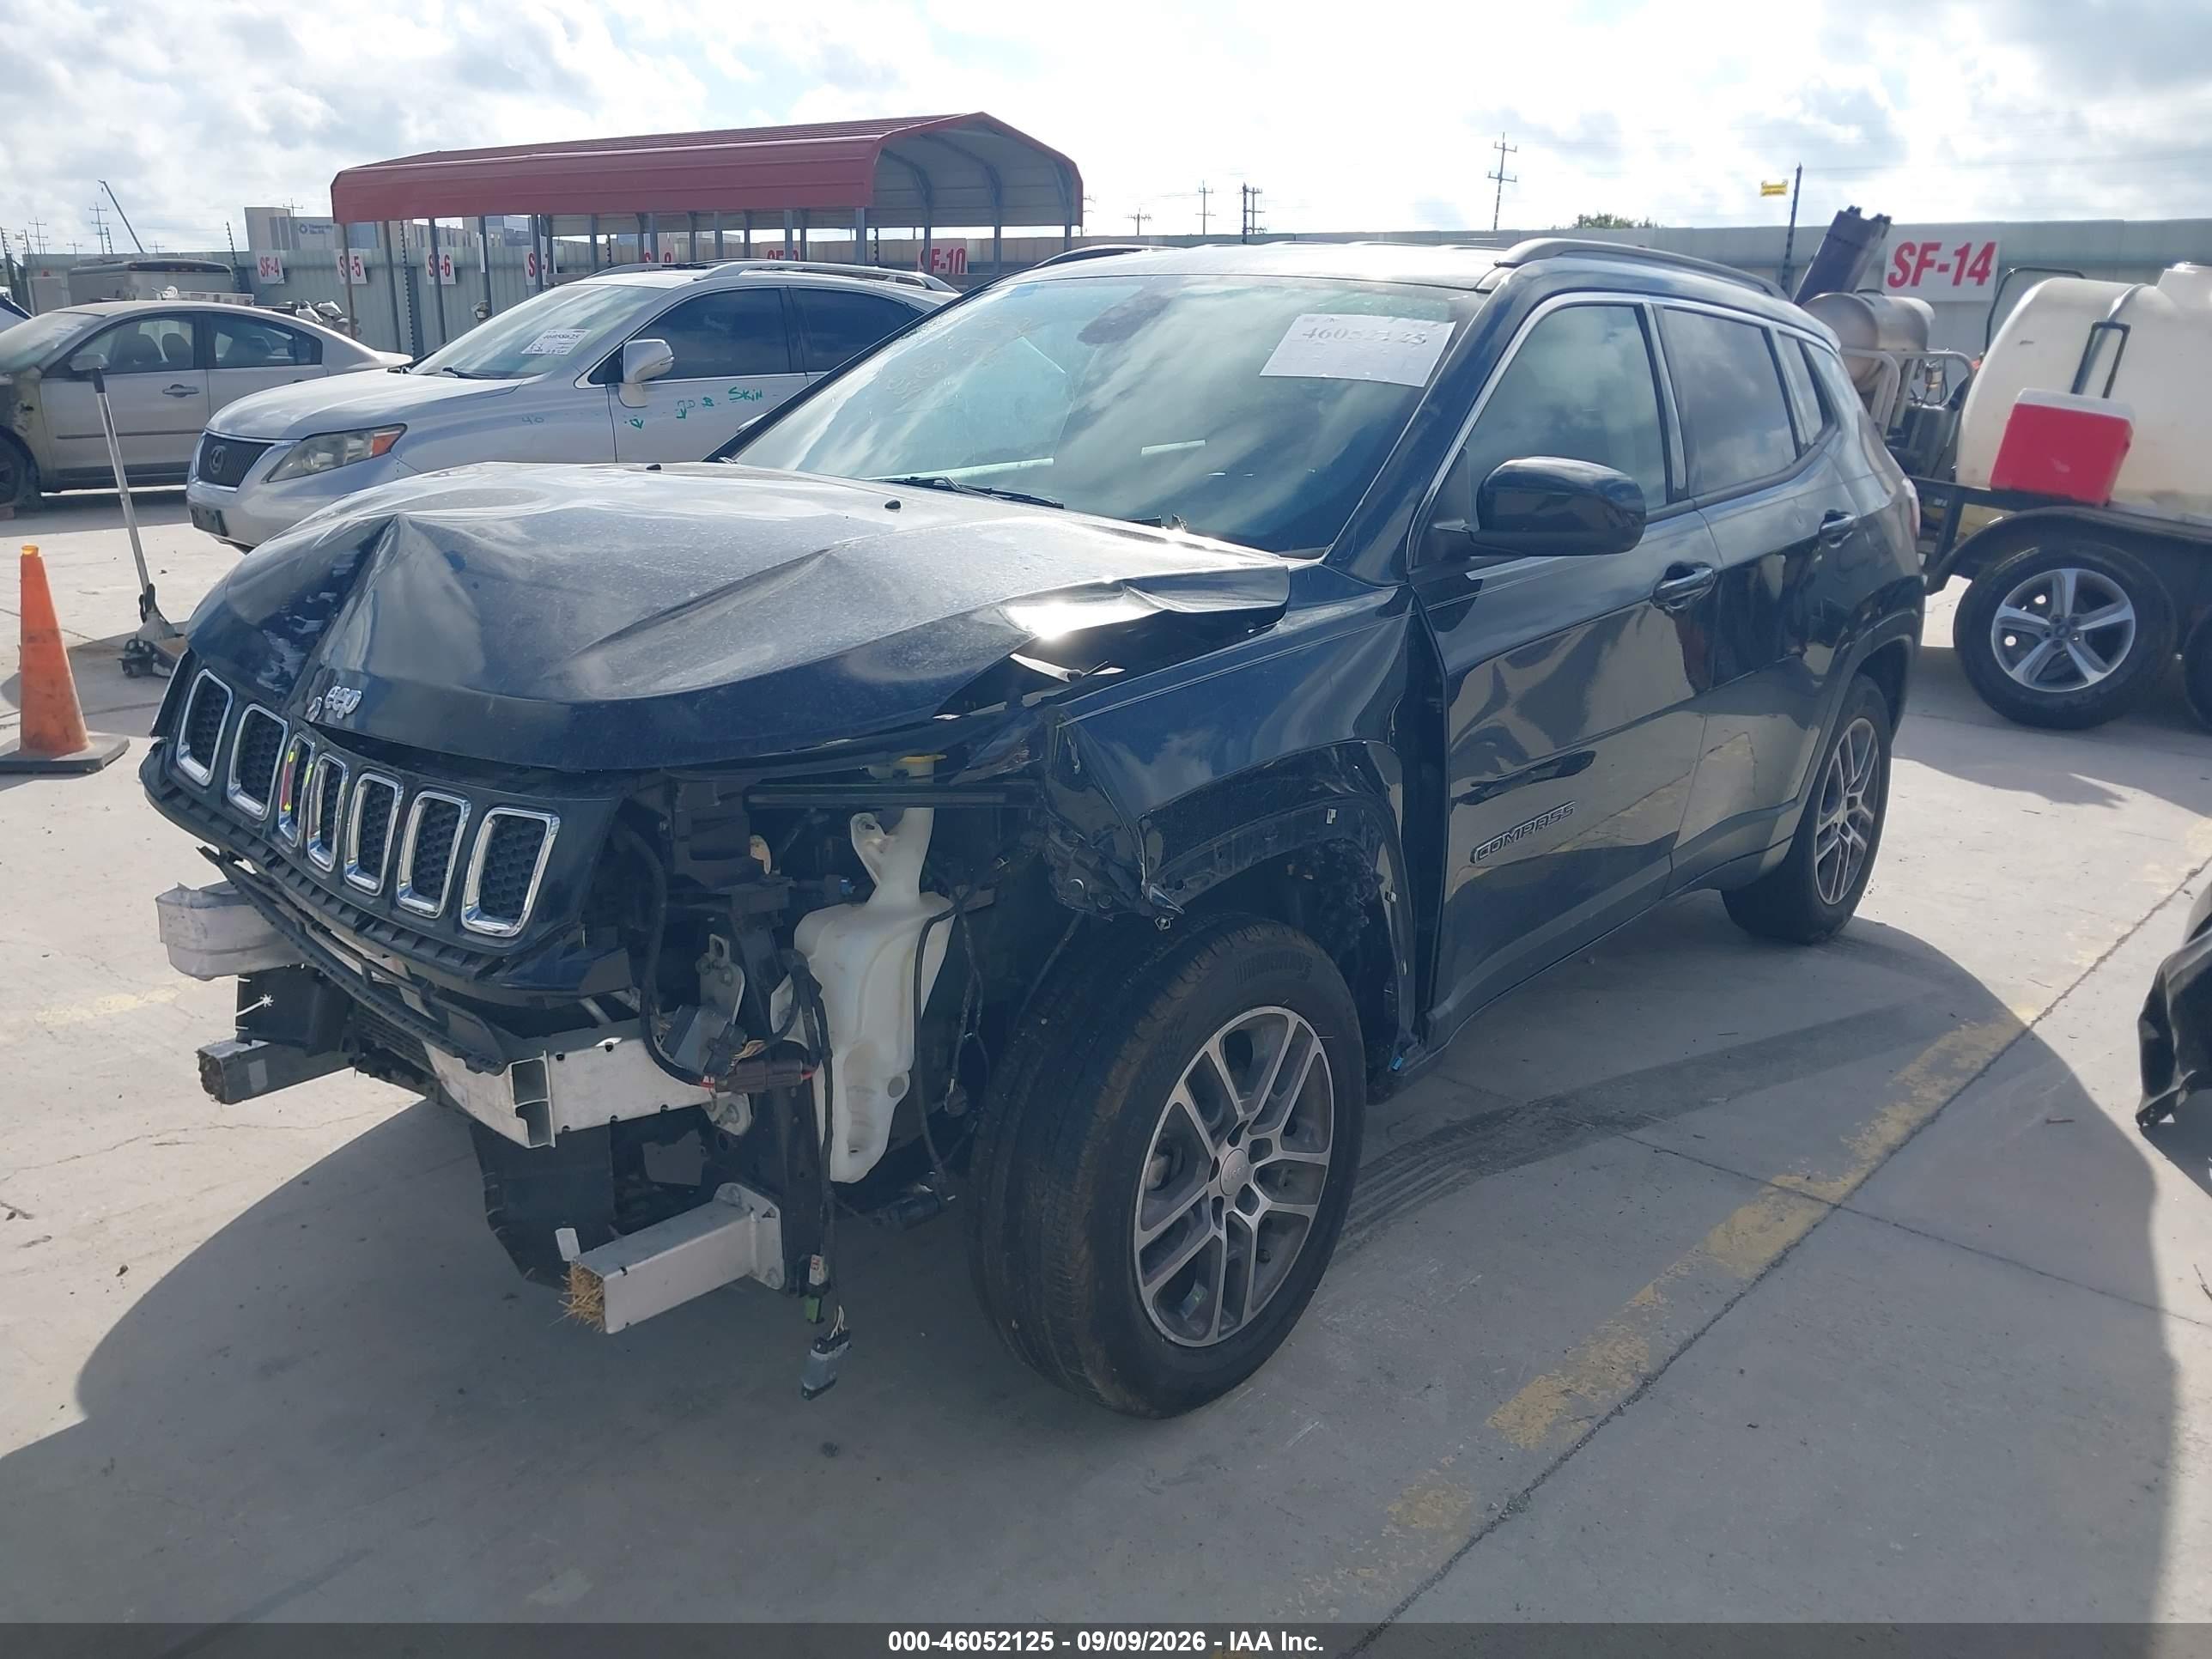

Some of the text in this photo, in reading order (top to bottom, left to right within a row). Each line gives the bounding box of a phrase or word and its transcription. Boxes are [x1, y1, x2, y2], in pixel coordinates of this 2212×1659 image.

[260, 257, 280, 277] SF-4
[339, 256, 361, 277] S-5
[428, 254, 451, 277] S-6
[1887, 241, 1996, 288] SF-14
[1470, 800, 1576, 864] COMPASS
